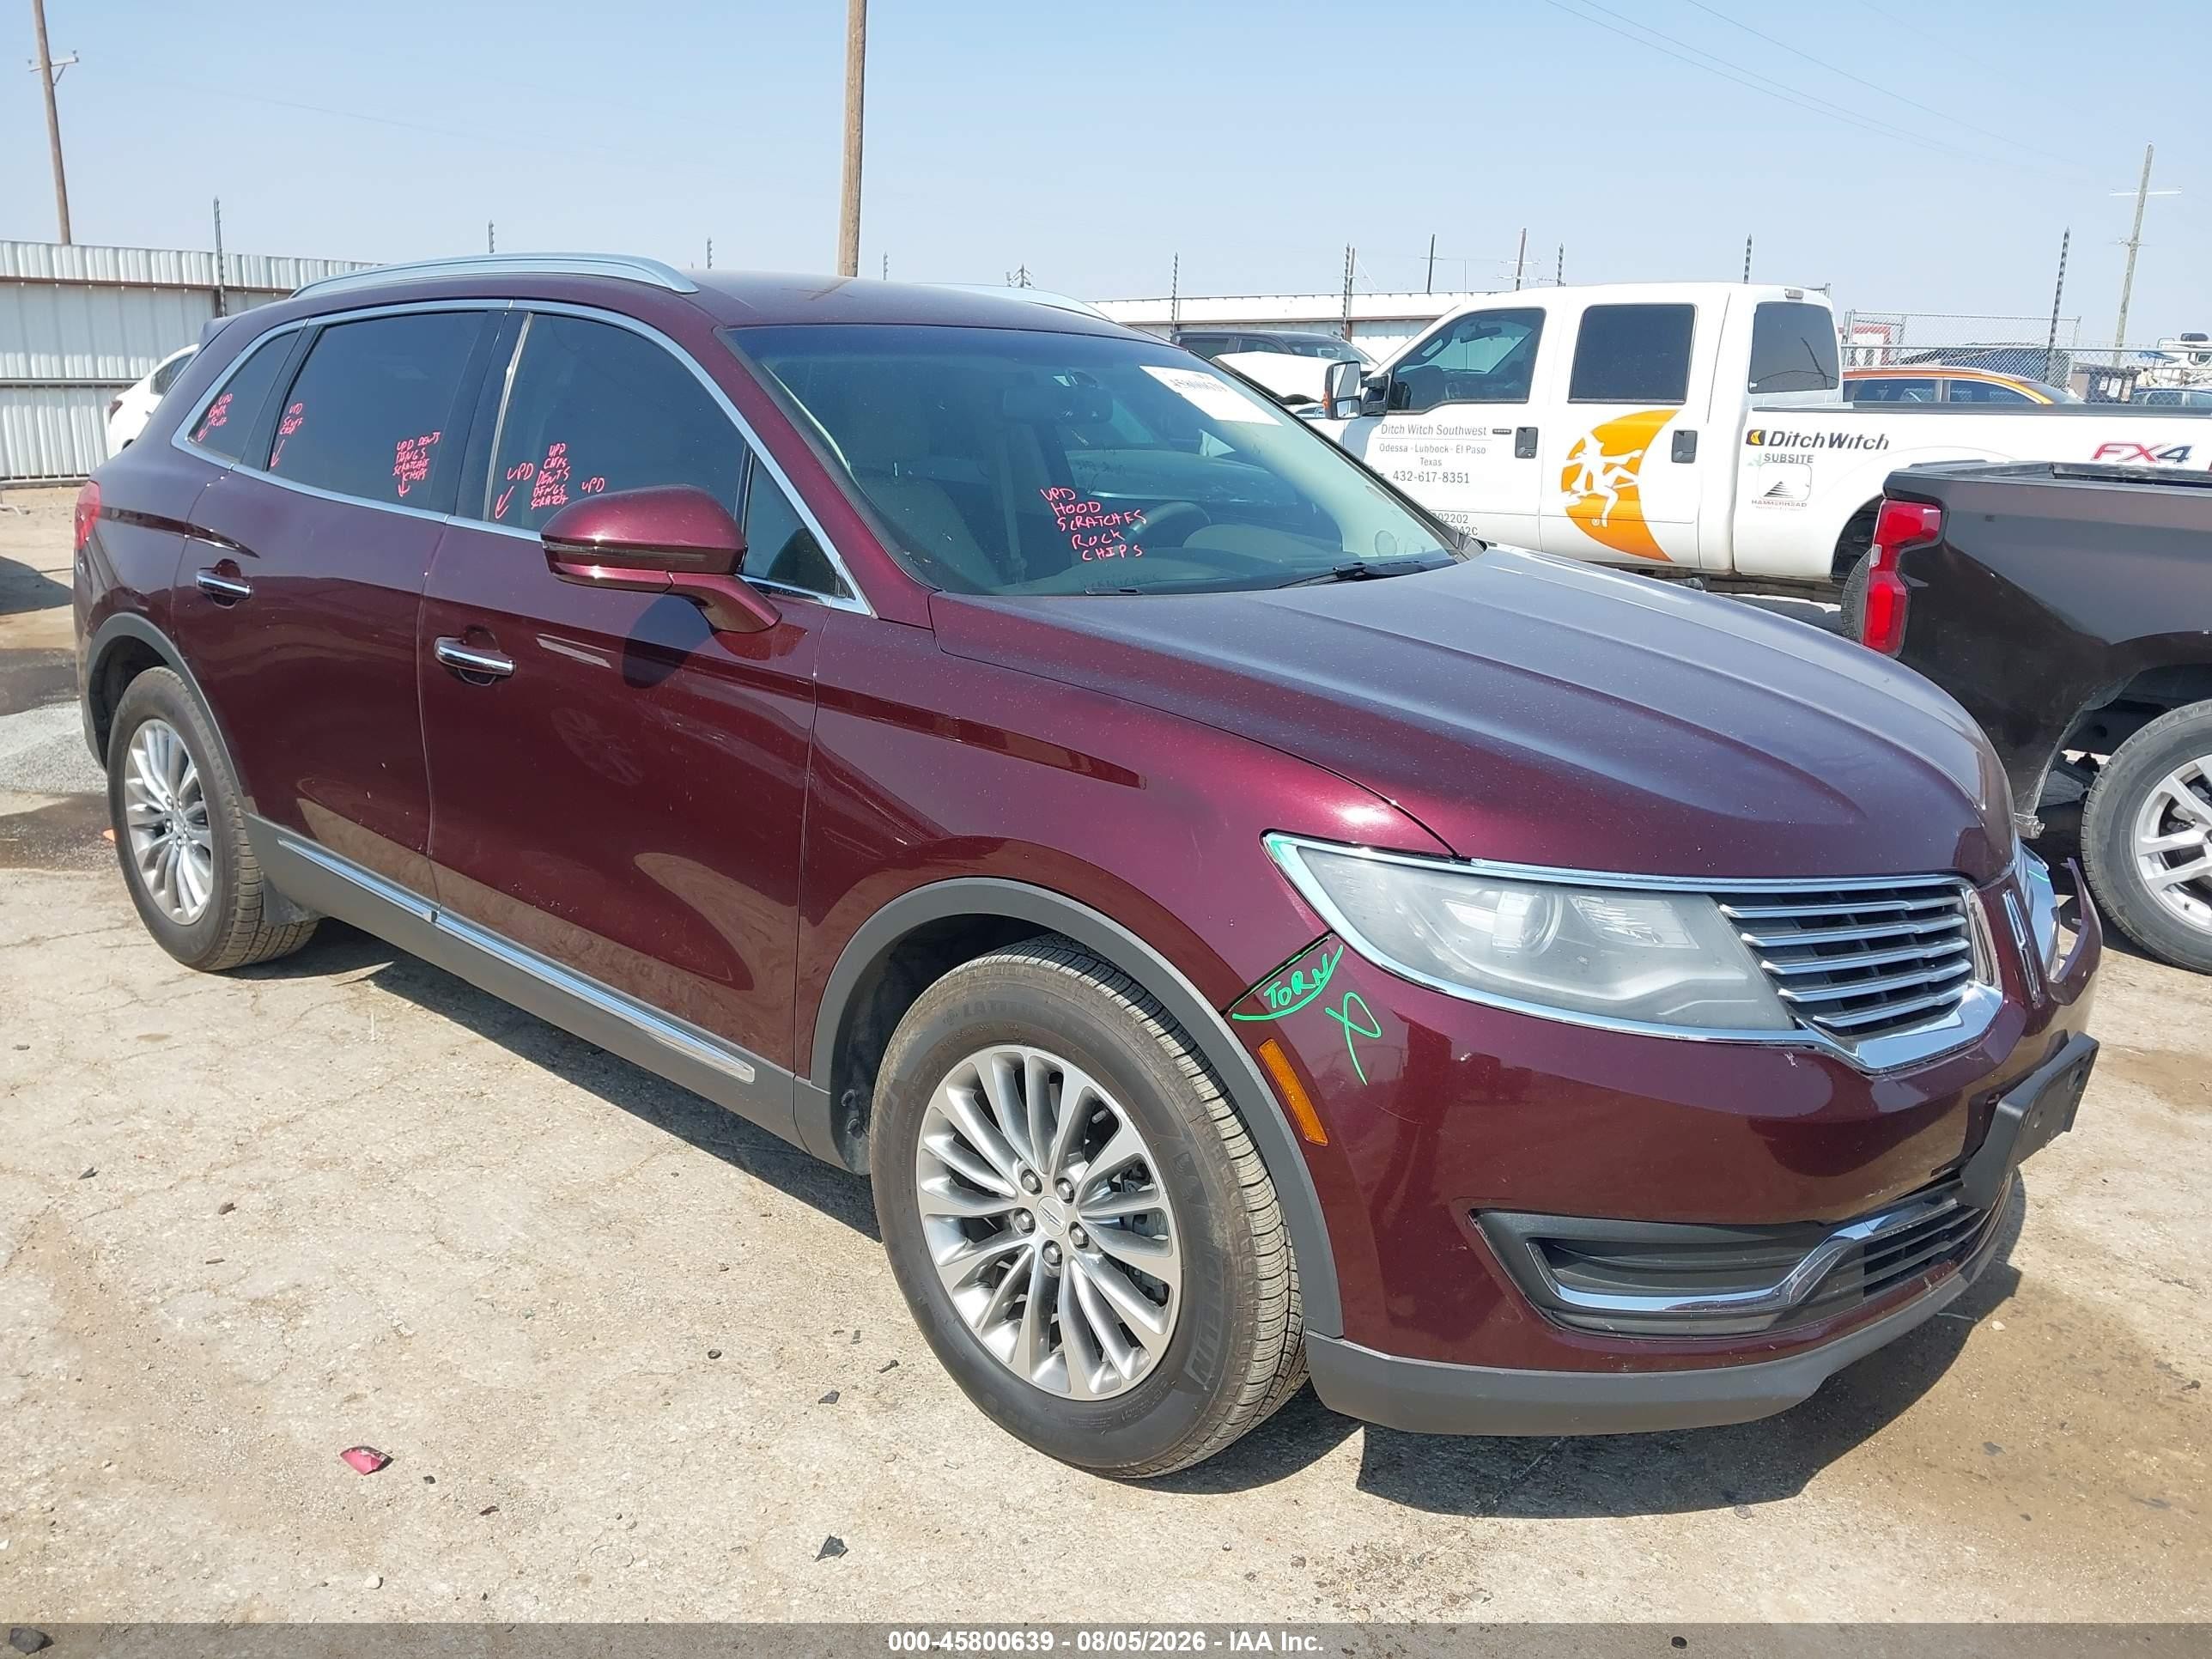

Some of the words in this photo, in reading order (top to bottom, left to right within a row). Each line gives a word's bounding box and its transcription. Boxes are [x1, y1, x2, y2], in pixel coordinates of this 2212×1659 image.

[1381, 423, 1405, 435] Ditch
[1407, 424, 1433, 436] Witch
[1436, 424, 1487, 436] Southwest
[1379, 443, 1408, 453] Odessa
[1414, 445, 1449, 453] Lubbock
[1466, 446, 1486, 454] Paso
[2090, 441, 2194, 465] FX4
[1420, 458, 1443, 466] Texas
[1764, 453, 1814, 464] SUBSITE
[1393, 471, 1470, 483] 432-617-8351
[1050, 501, 1101, 518] HOOD
[1057, 509, 1147, 532] SCRATCHES
[1432, 513, 1468, 524] 02202
[1082, 544, 1143, 561] CHIPS
[1264, 953, 1328, 1009] TORN
